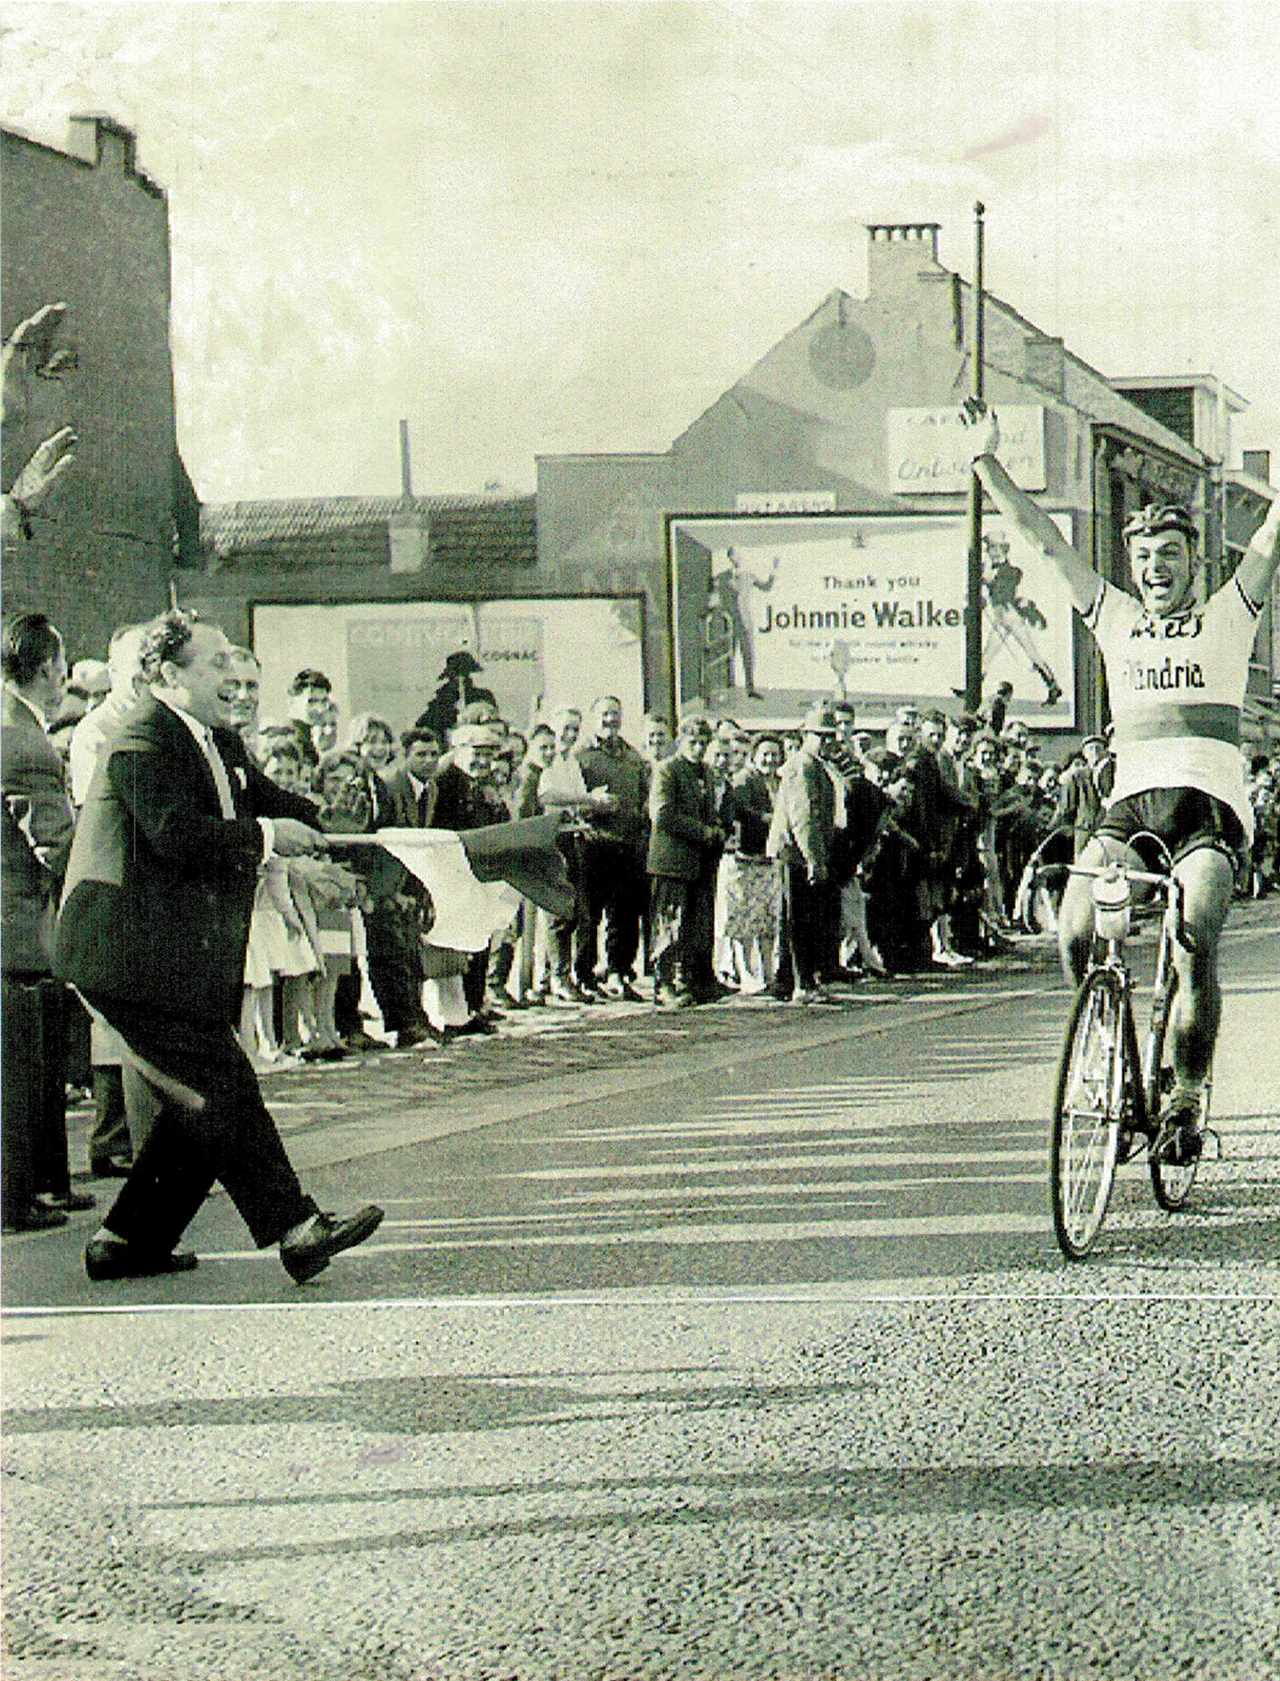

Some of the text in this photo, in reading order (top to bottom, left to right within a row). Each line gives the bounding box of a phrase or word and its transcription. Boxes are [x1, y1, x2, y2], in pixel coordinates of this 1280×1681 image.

[823, 575, 920, 592] Thank you
[758, 600, 968, 634] Johnnie Walke
[482, 650, 537, 662] COGNAC
